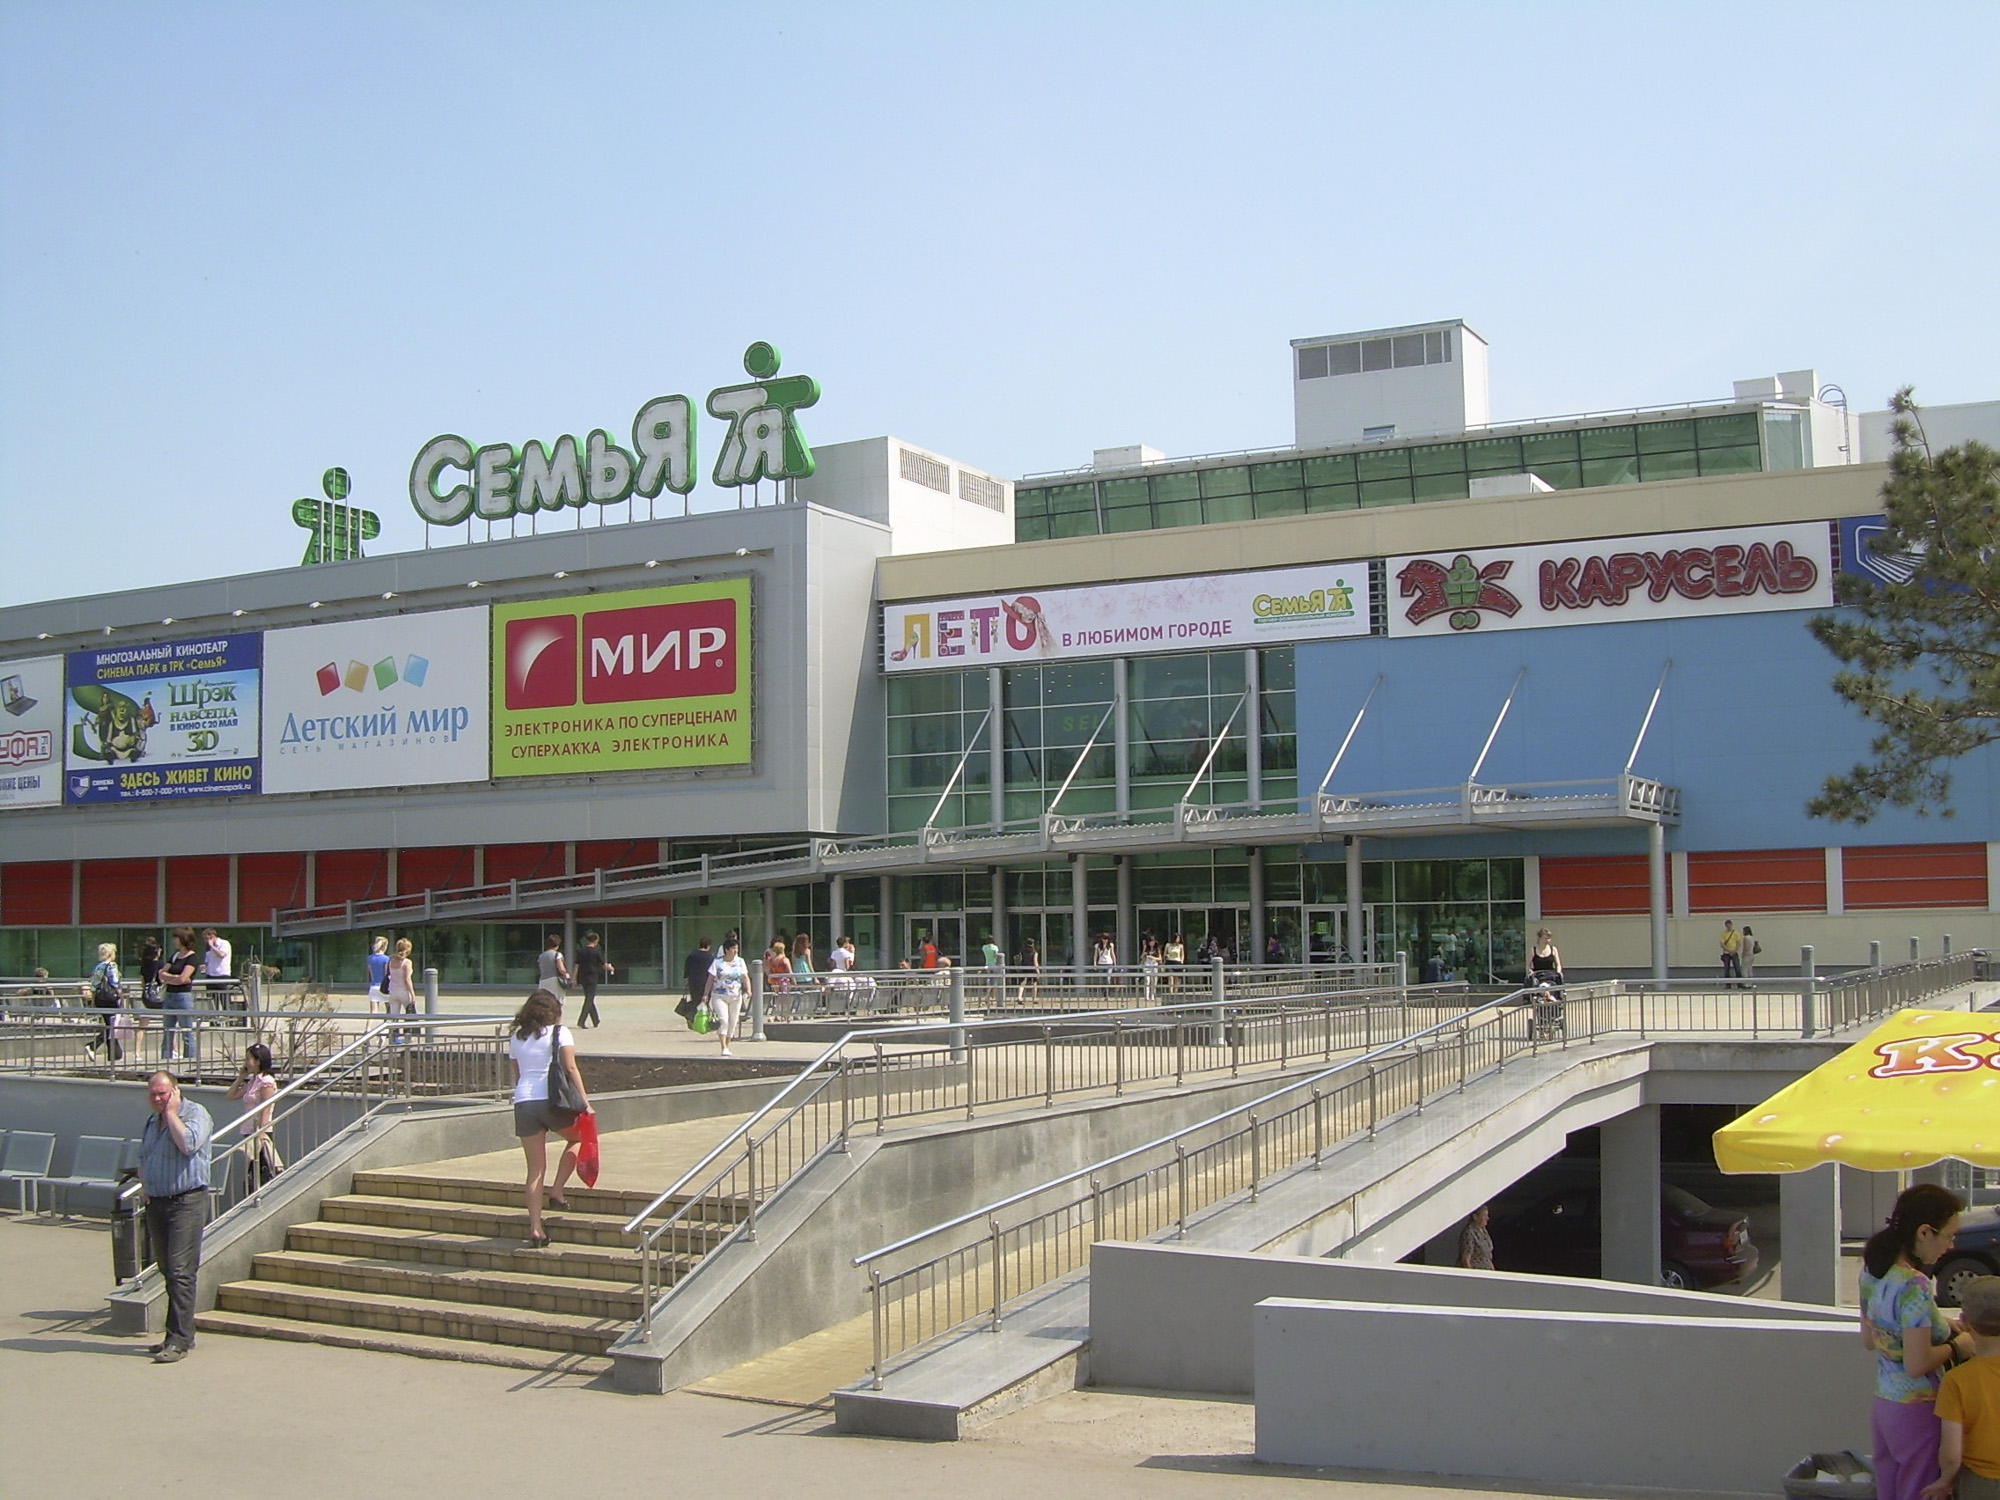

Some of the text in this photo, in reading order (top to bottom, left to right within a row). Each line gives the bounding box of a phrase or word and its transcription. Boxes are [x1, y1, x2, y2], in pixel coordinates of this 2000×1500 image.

[1538, 540, 1817, 611] КАРУСЕЛЬ
[890, 595, 1042, 662] ЛЕТО
[1062, 619, 1232, 647] В ЛЮБИМОМ ГОРОДЕ
[96, 640, 228, 665] МНОГОЗАЛЬНЫЙ КИНОТЕАТР
[591, 627, 727, 678] МИР
[97, 665, 135, 680] СИНЕМА
[136, 662, 161, 675] ПАРК
[169, 659, 185, 672] ТРК
[170, 707, 238, 722] НАВСЕГДА
[177, 721, 200, 731] КИНО
[207, 720, 217, 729] 20
[218, 718, 238, 727] МАЯ
[280, 705, 469, 744] Детский мир
[504, 708, 738, 737] ЭЛЕКТРОНИКА ПО СУПЕРЦЕНАМ
[187, 729, 220, 752] 3D
[280, 735, 449, 755] СЕТЬ МАГАЗИНОВ
[612, 732, 729, 752] ЭЛЕКТРОНИКА
[120, 765, 253, 789] ЗДЕСЬ ЖИВЕТ КИНО
